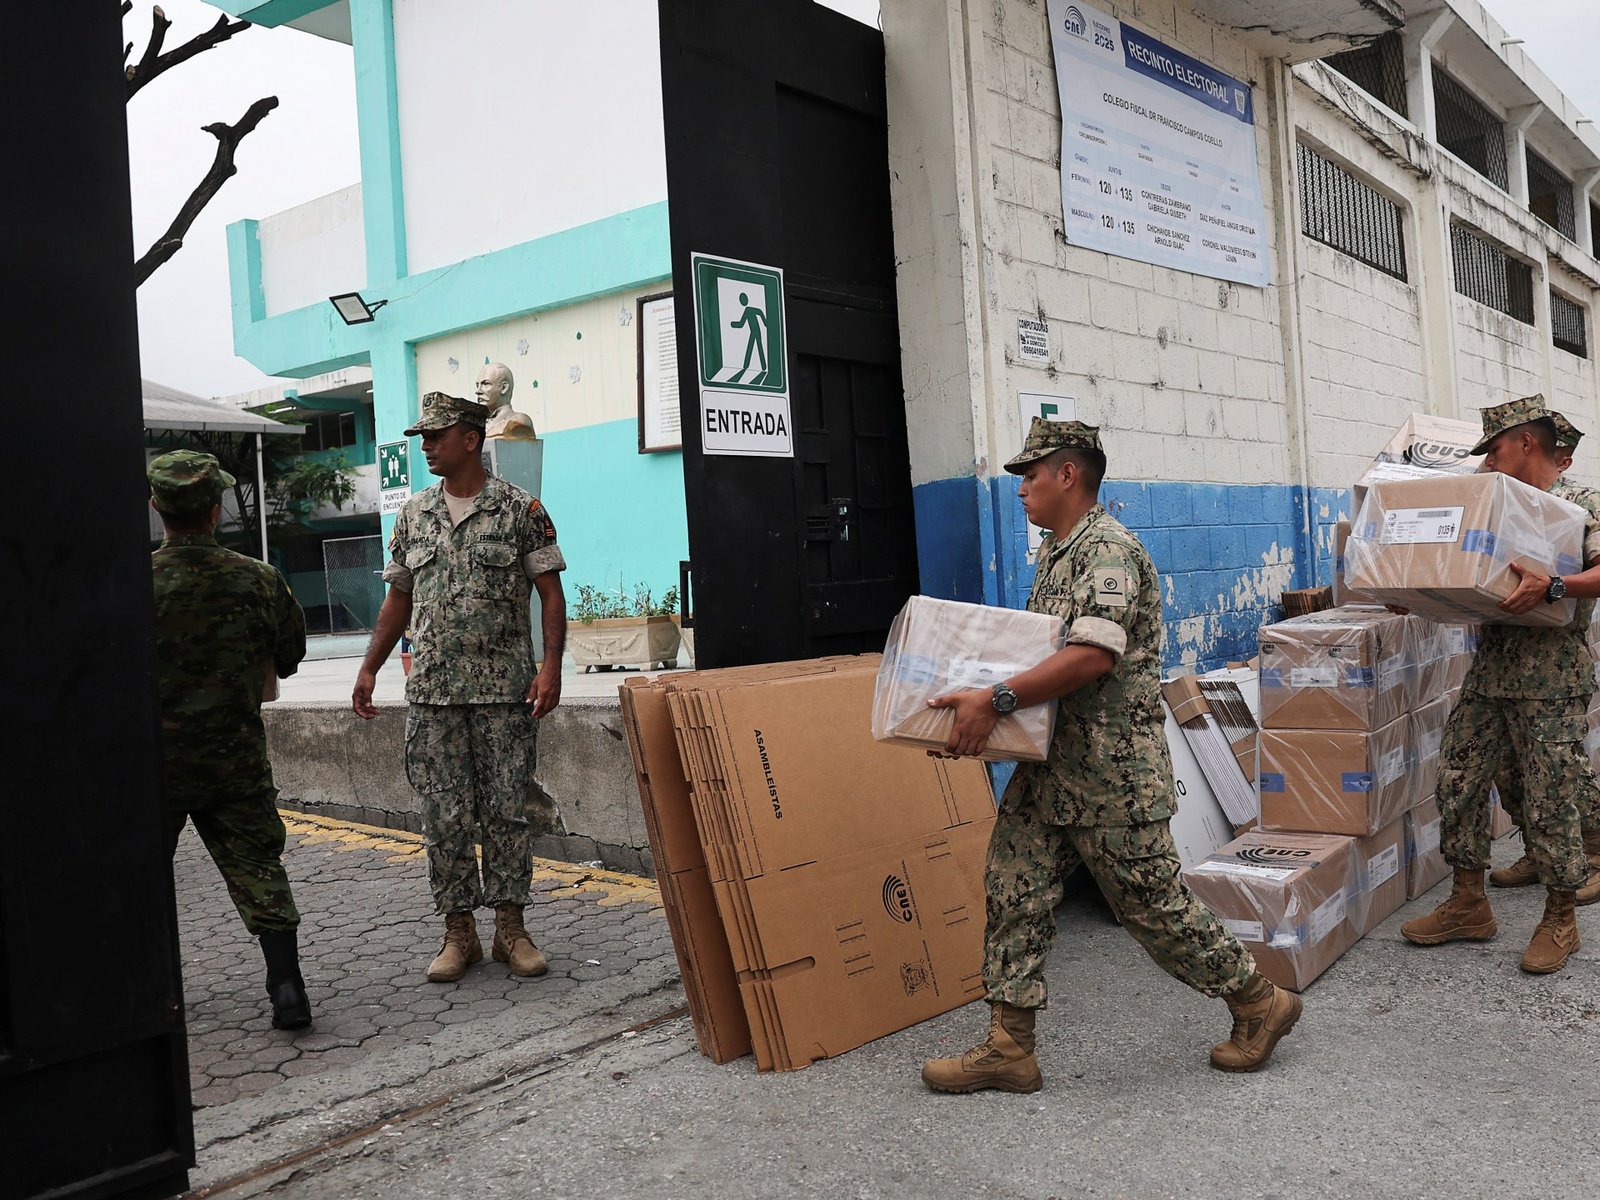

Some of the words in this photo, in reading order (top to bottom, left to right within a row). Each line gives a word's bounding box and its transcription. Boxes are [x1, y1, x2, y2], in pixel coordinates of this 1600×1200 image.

[1094, 33, 1114, 52] 2025
[1128, 40, 1174, 76] RECINTO
[1175, 64, 1229, 104] ELECTORAL
[1103, 92, 1130, 110] COLEGIO
[1130, 102, 1148, 118] FISCAL
[1149, 111, 1157, 121] DR
[1157, 114, 1184, 132] FRANCISCO
[1184, 126, 1204, 140] CAMPOS
[1204, 134, 1223, 148] COELLO
[1099, 180, 1112, 195] 120
[1120, 186, 1132, 202] 135
[1141, 190, 1168, 206] CONTRERAS
[1168, 198, 1192, 212] ZAMBRANO
[1148, 202, 1169, 216] GABRIELA
[1102, 214, 1114, 230] 120
[1122, 220, 1135, 235] 135
[1018, 319, 1048, 333] COMPUTADORAS
[706, 408, 787, 436] ENTRADA
[1427, 444, 1470, 459] CNE
[385, 493, 399, 501] PUNTO
[754, 729, 782, 820] ASAMBLEÍSTAS
[1263, 848, 1311, 856] CNE
[897, 890, 912, 922] CNE
